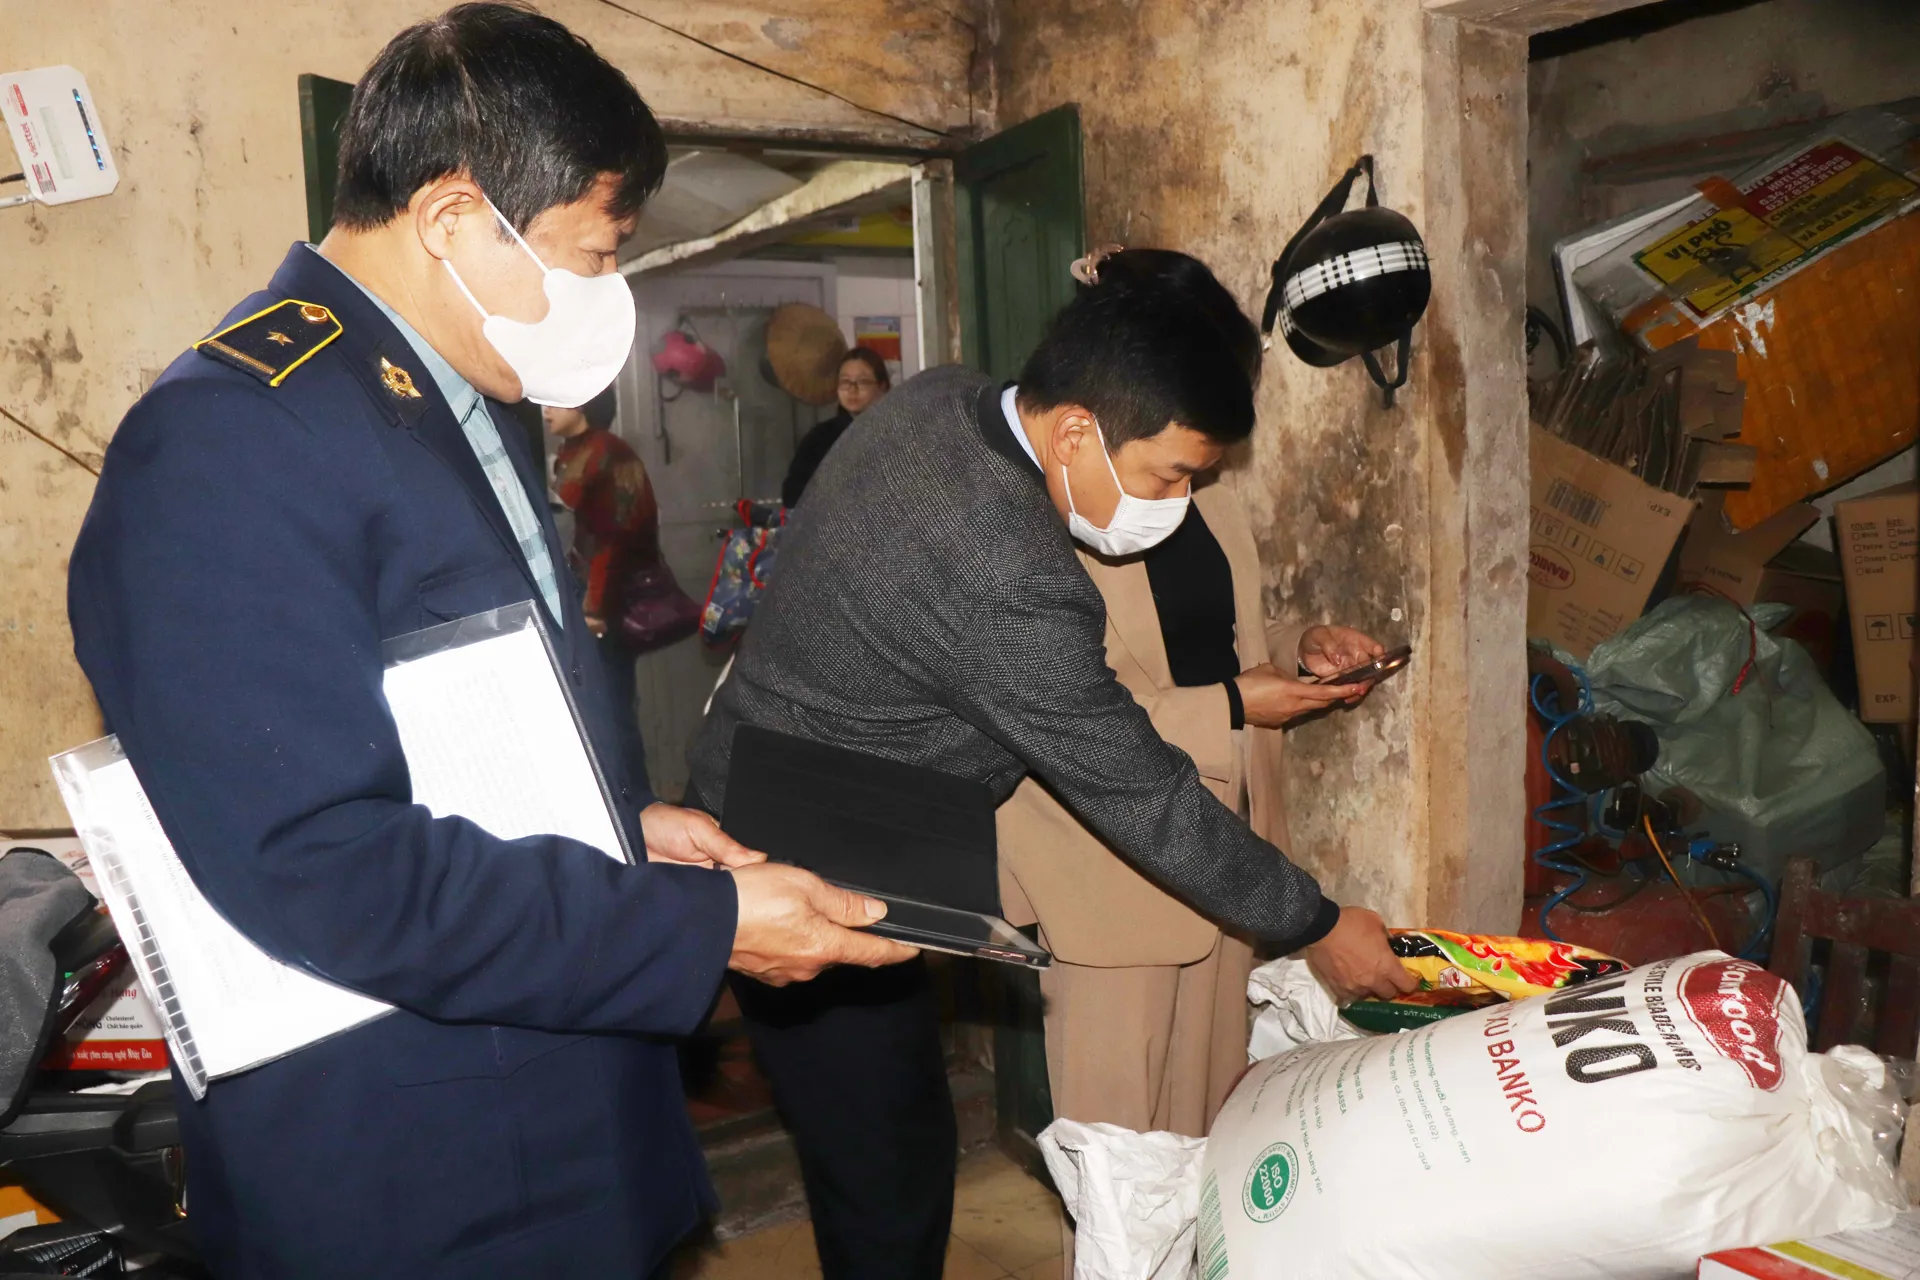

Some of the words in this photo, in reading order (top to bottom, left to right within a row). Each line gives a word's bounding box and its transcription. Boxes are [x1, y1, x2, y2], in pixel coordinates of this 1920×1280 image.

[20, 122, 38, 158] viettel
[1487, 1040, 1546, 1133] BANKO
[1259, 1164, 1274, 1206] 22000
[1270, 1162, 1283, 1189] ISO
